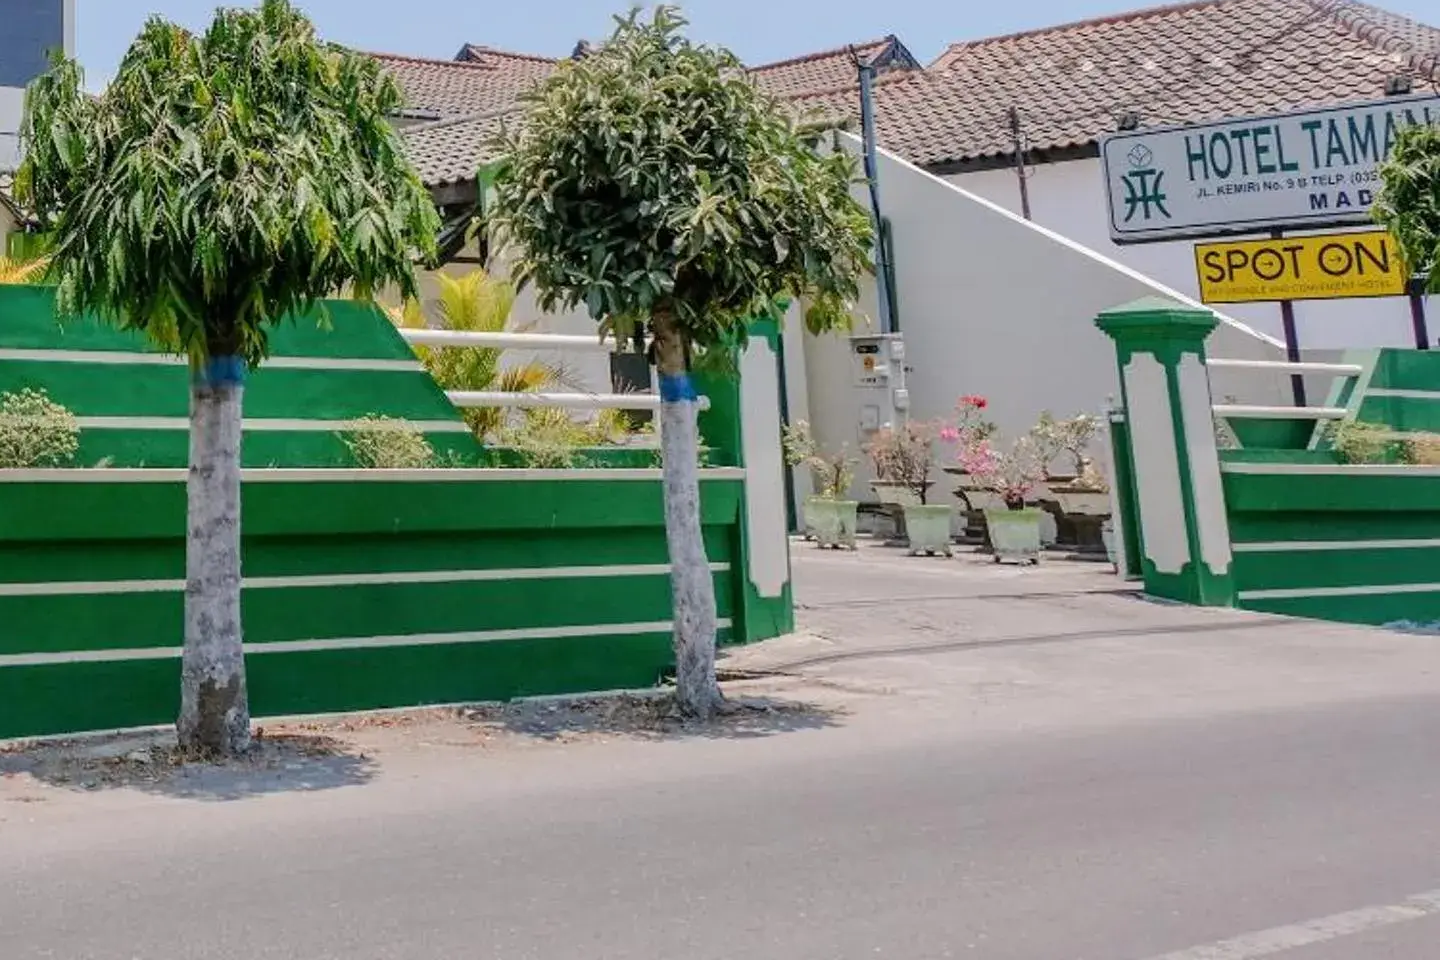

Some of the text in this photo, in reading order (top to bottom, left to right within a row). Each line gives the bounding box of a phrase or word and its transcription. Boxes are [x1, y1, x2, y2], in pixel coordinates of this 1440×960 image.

[1184, 125, 1299, 181] HOTEL
[1216, 181, 1260, 197] KEMIRI
[1310, 190, 1374, 210] MAD
[1204, 240, 1390, 283] SPOT ON
